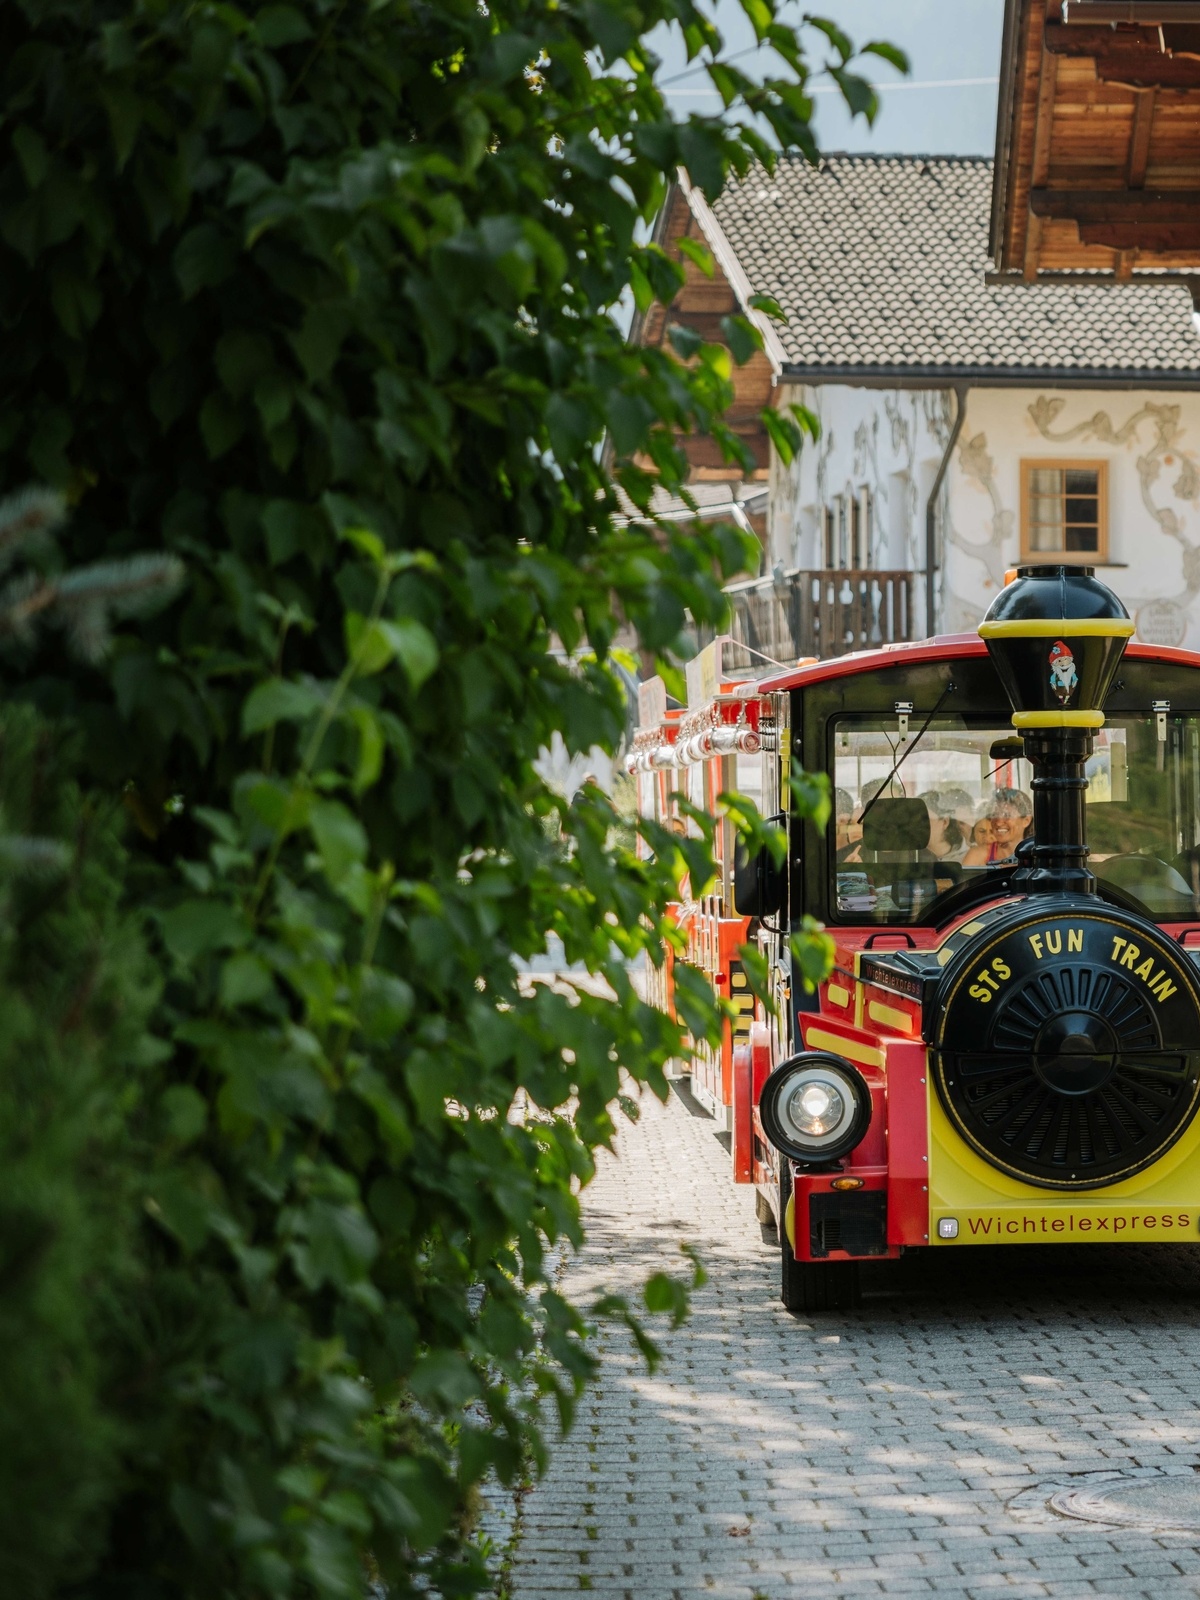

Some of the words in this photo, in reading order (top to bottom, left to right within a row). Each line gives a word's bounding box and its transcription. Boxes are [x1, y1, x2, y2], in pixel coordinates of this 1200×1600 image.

[866, 964, 921, 995] Wichtelexpress
[968, 956, 1012, 1003] STS
[1028, 928, 1084, 960] FUN
[1110, 935, 1178, 1003] TRAIN
[967, 1213, 1191, 1236] Wichtelexpress
